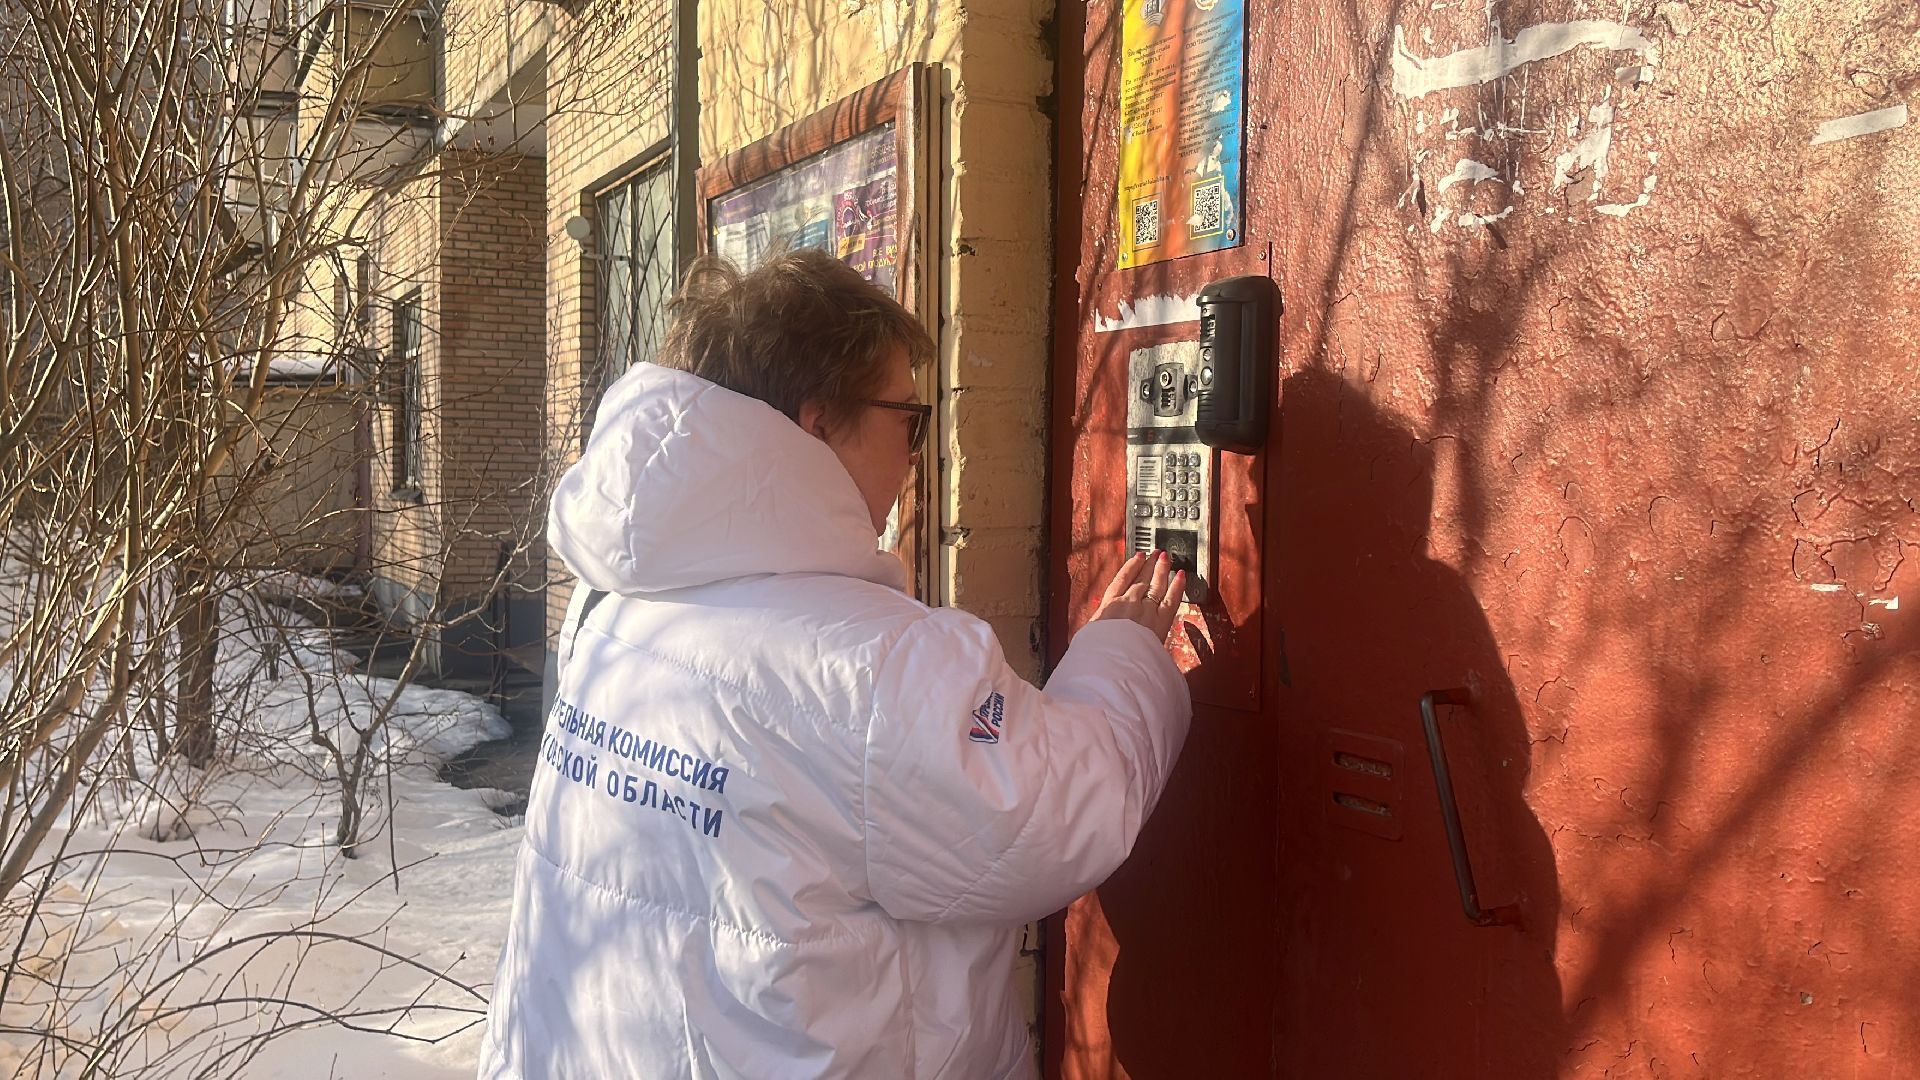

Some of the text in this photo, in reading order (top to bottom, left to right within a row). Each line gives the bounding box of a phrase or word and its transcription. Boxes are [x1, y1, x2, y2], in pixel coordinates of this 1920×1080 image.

[992, 692, 1005, 727] РОССИИ
[608, 726, 730, 794] КОМИССИЯ
[607, 771, 723, 838] ОБЛАСТИ
